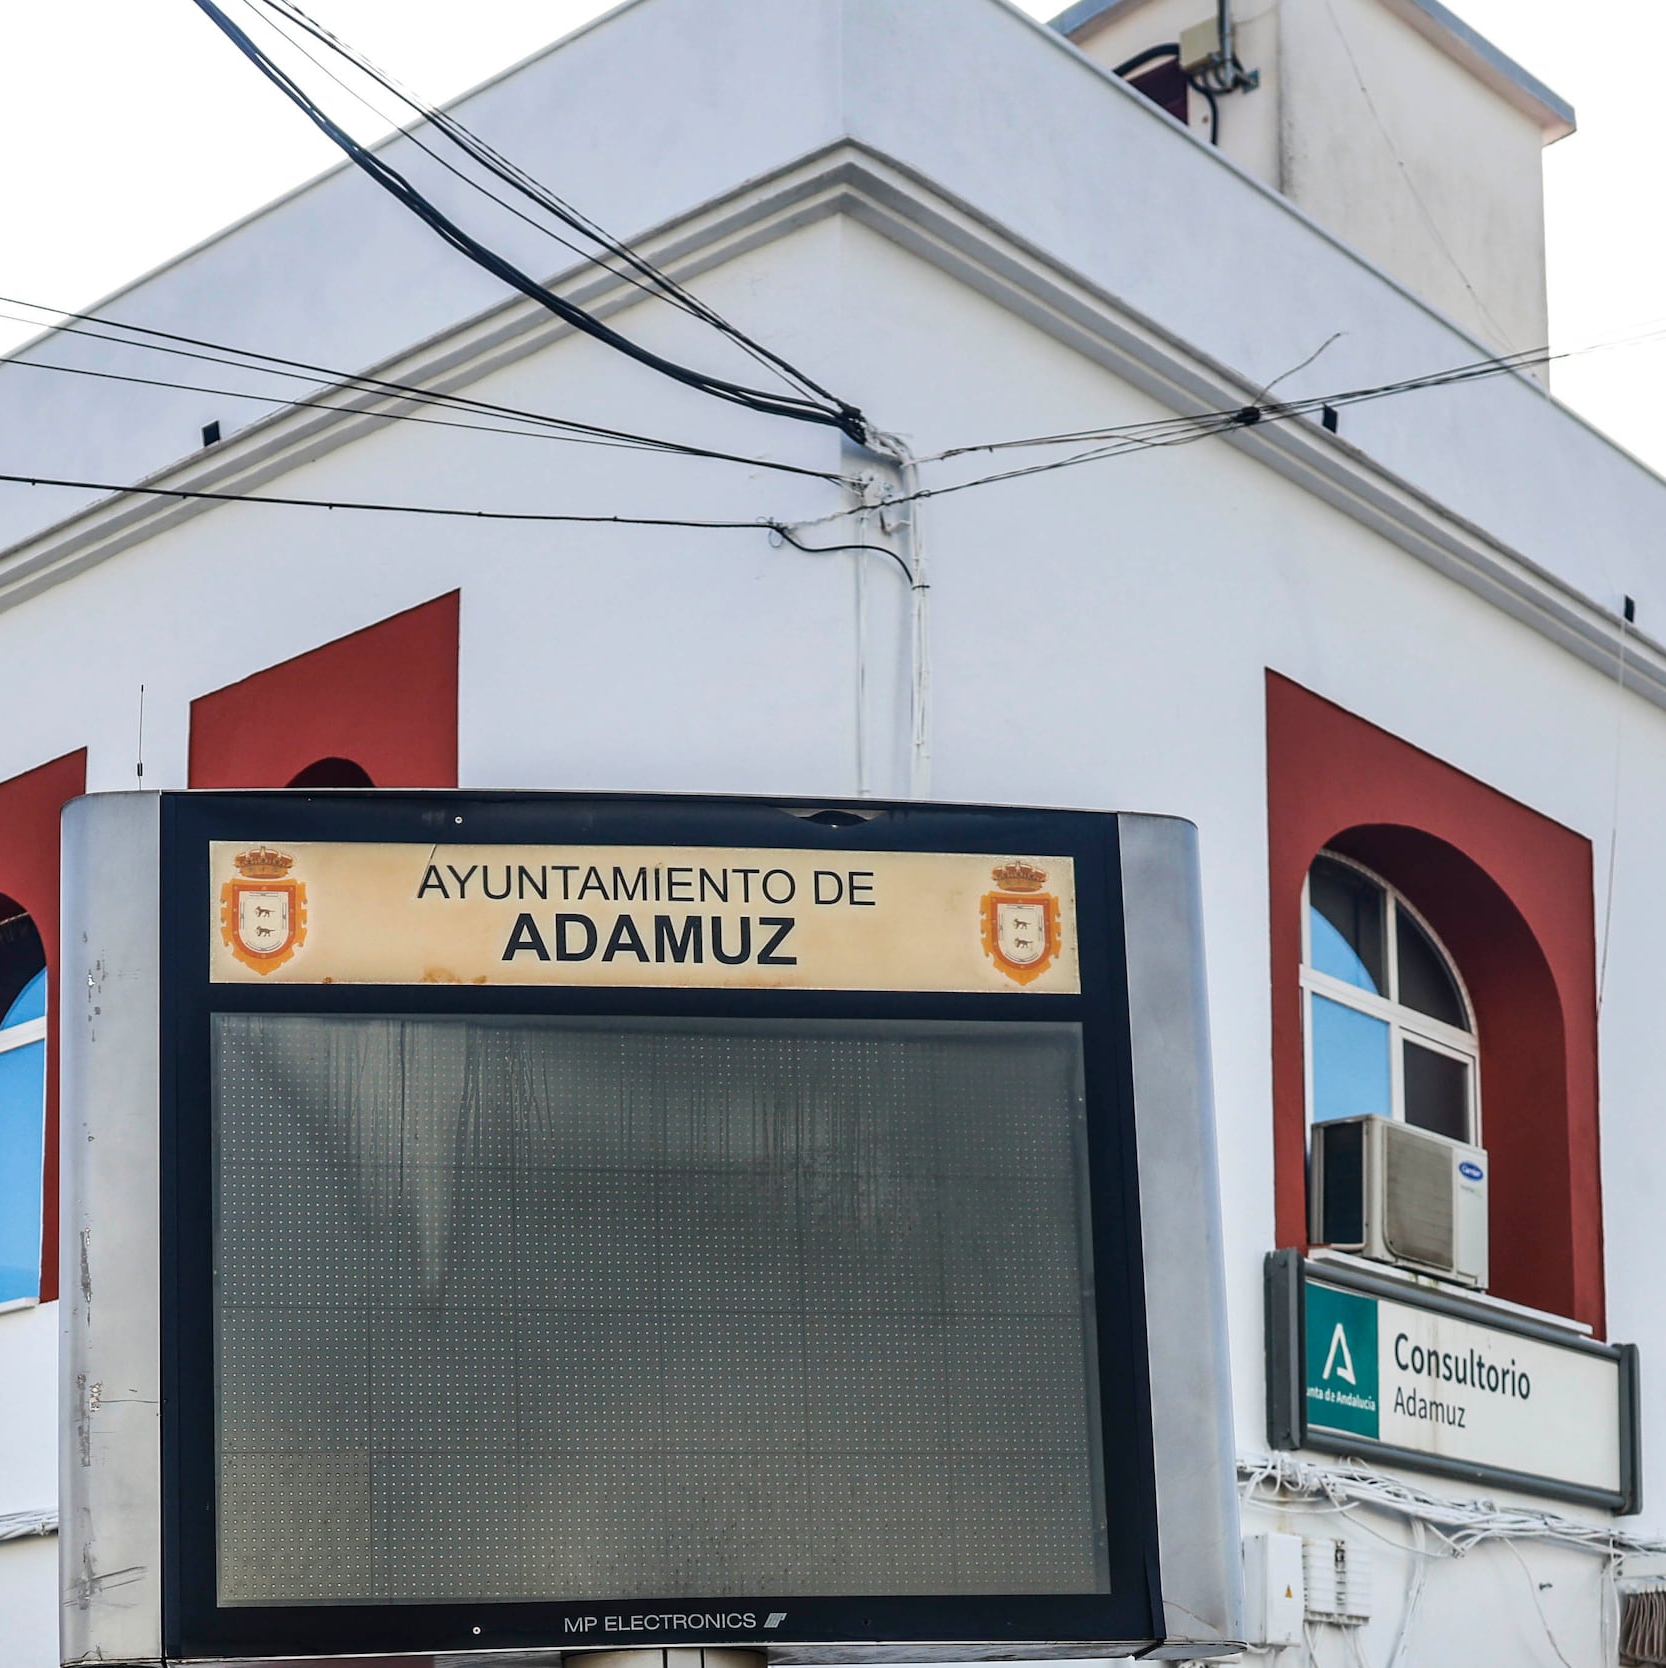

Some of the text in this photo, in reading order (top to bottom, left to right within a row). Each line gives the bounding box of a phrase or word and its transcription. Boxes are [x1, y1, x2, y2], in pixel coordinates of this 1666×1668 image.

[417, 865, 876, 906] AYUNTAMIENTO DE
[501, 912, 798, 966] ADAMUZ
[1394, 1332, 1531, 1400] Consultorio
[1393, 1387, 1466, 1429] Adamuz
[564, 1613, 757, 1633] MP ELECTRONICS
